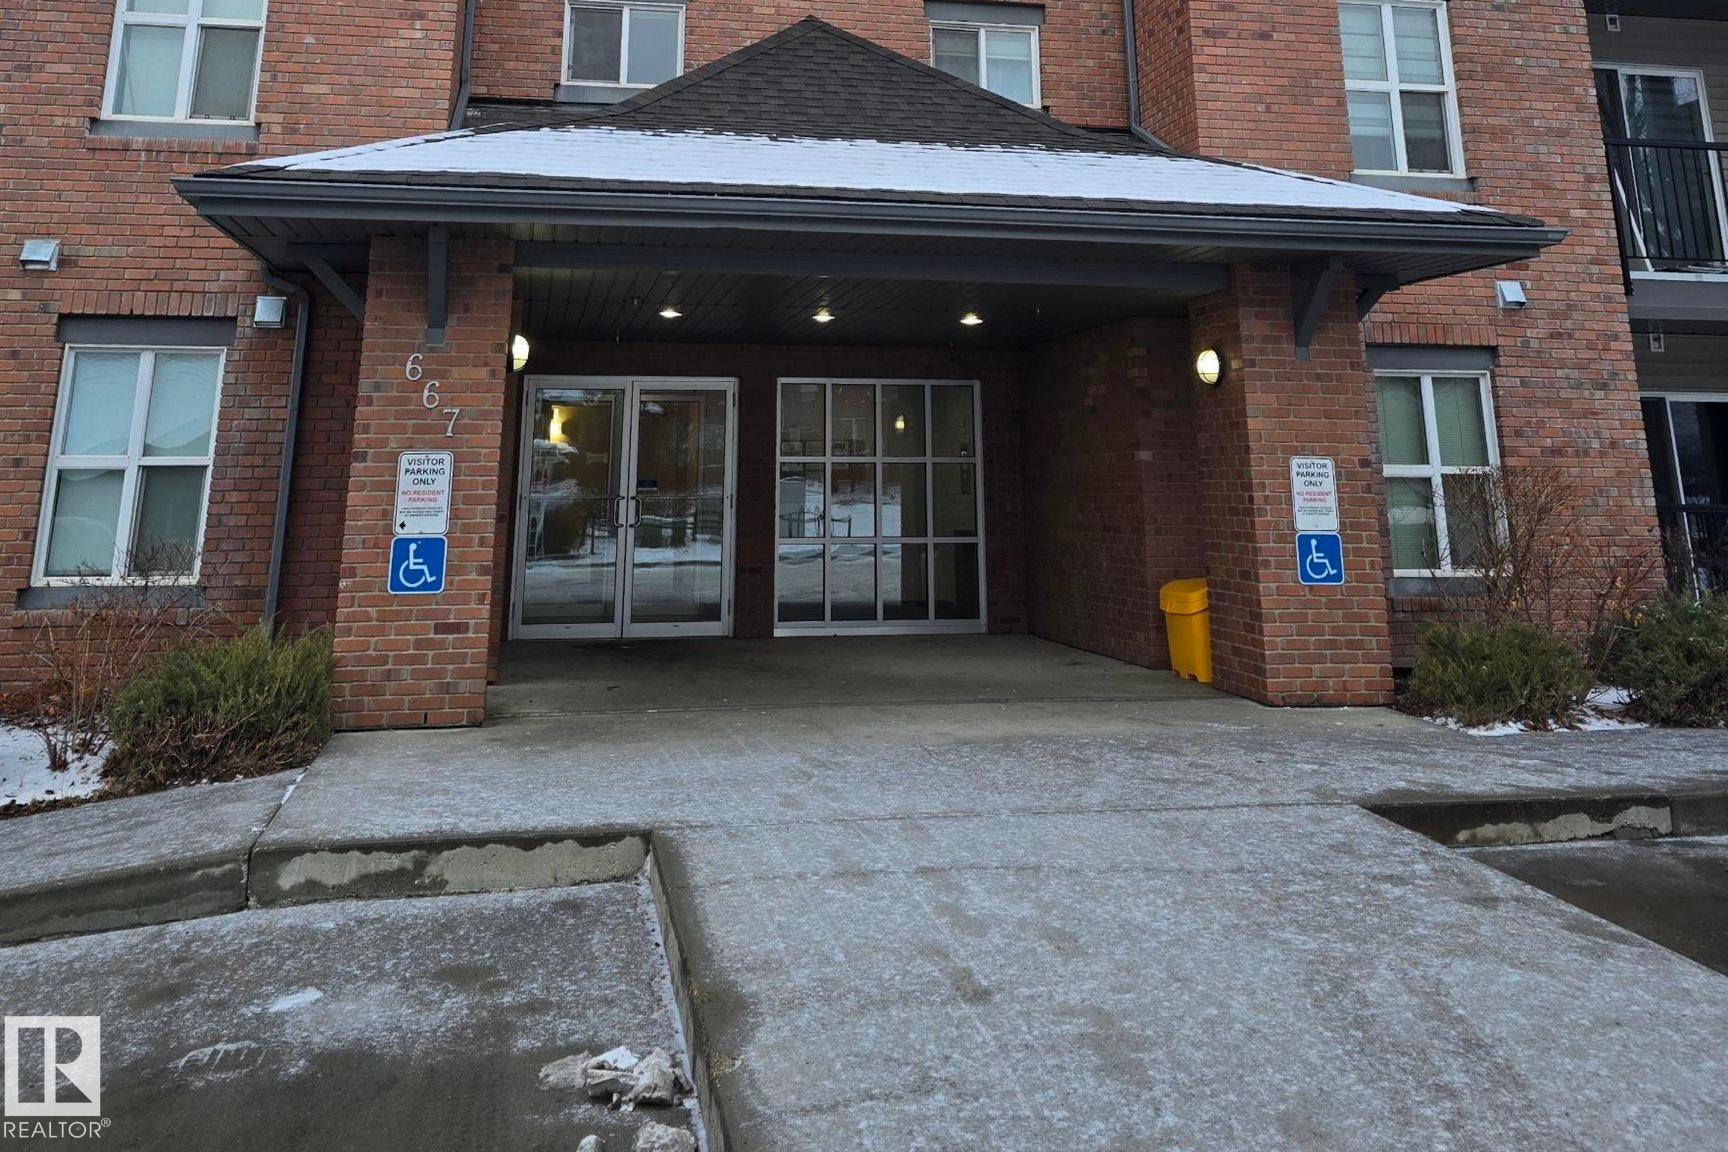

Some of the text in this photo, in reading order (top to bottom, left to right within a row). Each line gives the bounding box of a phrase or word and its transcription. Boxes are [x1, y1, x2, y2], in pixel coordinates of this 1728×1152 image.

[407, 458, 445, 466] VISITOR
[1296, 462, 1328, 470] VISITOR
[404, 467, 446, 476] PARKING
[1295, 471, 1330, 479] PARKING
[412, 477, 437, 486] ONLY
